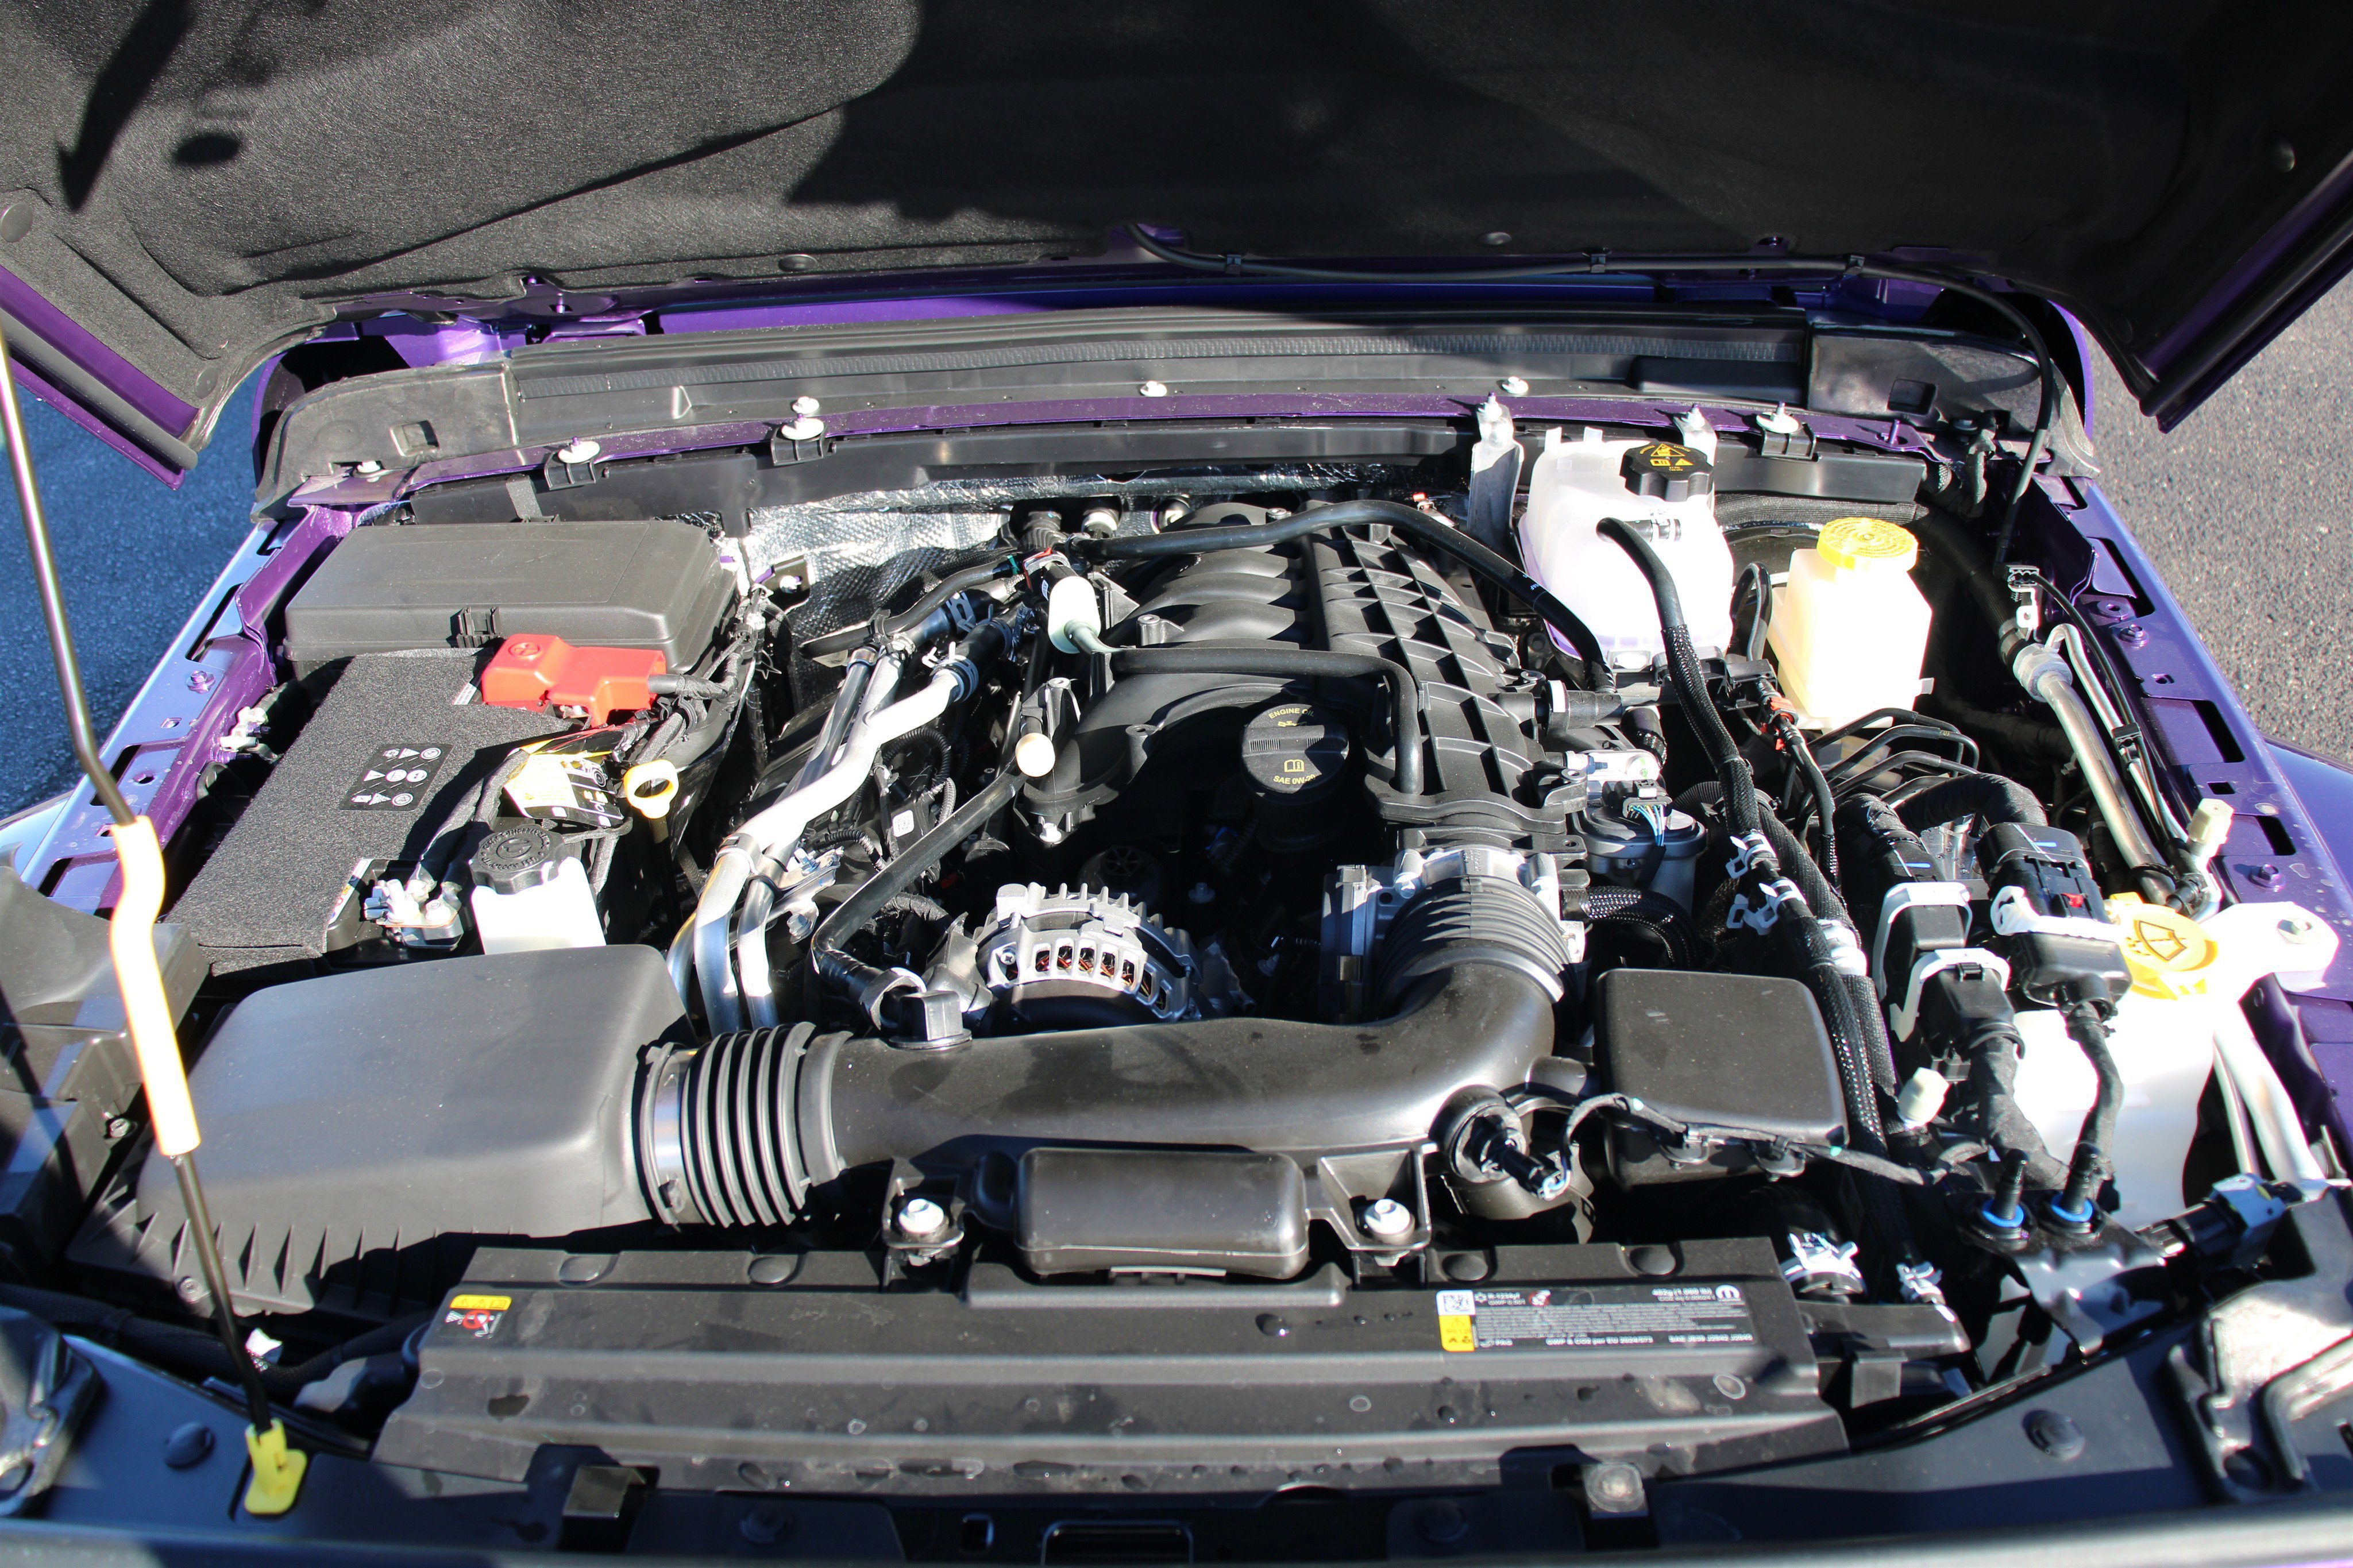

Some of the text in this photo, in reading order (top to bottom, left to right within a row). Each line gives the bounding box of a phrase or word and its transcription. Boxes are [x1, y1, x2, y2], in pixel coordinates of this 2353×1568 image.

[1268, 708, 1315, 719] ENGINE OIL
[1273, 774, 1316, 785] SAE 0W-20
[1574, 1337, 1592, 1345] CO2
[1668, 1335, 1687, 1343] SAE
